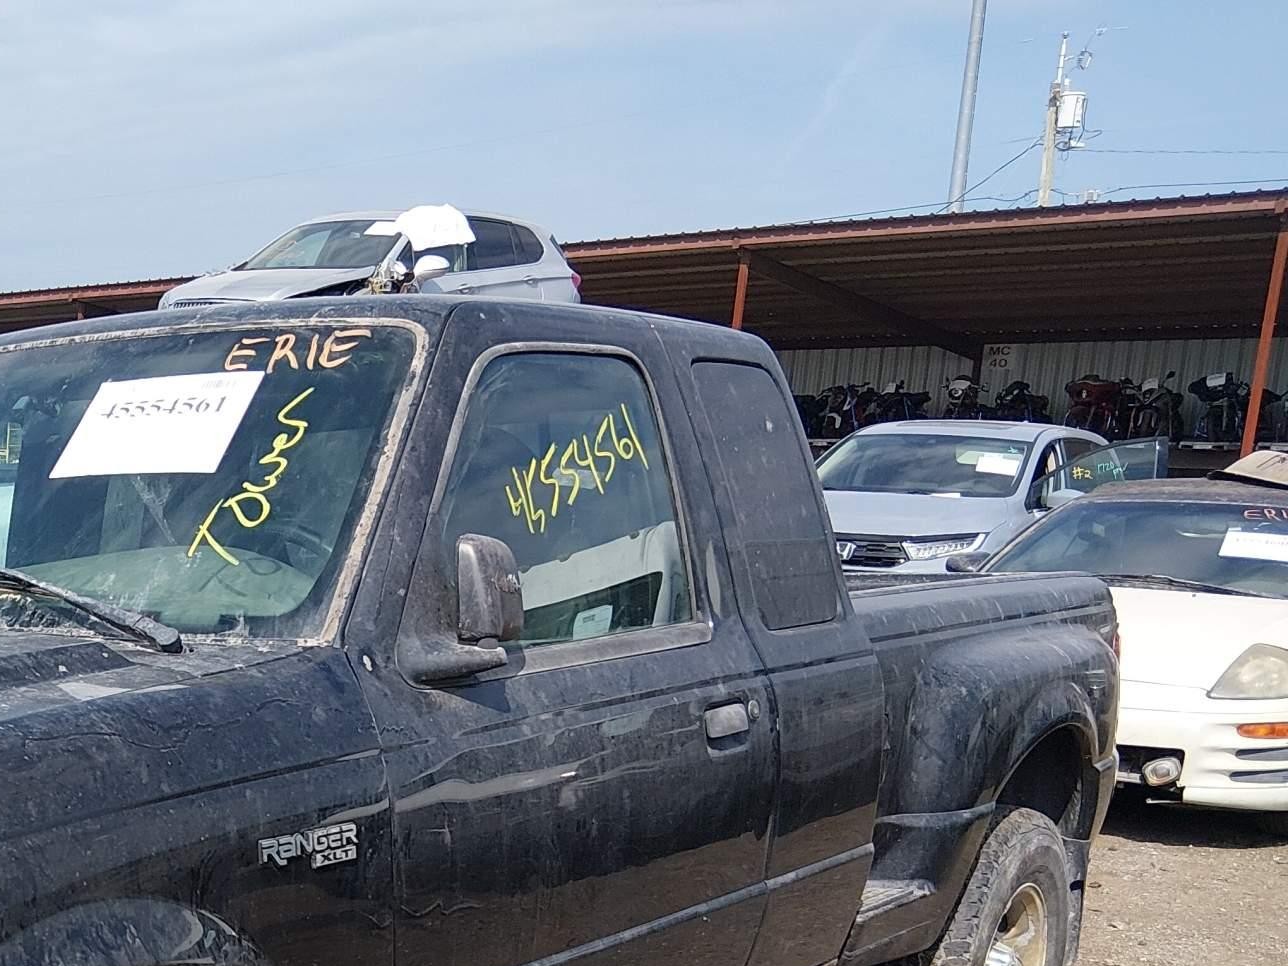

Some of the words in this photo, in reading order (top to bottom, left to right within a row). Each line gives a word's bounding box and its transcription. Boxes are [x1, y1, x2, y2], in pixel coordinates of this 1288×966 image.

[223, 329, 372, 375] ERIE
[988, 345, 1012, 357] MC
[988, 358, 1009, 369] 40
[1072, 465, 1094, 481] #2
[257, 821, 360, 867] RANGER
[316, 847, 355, 866] XLT
